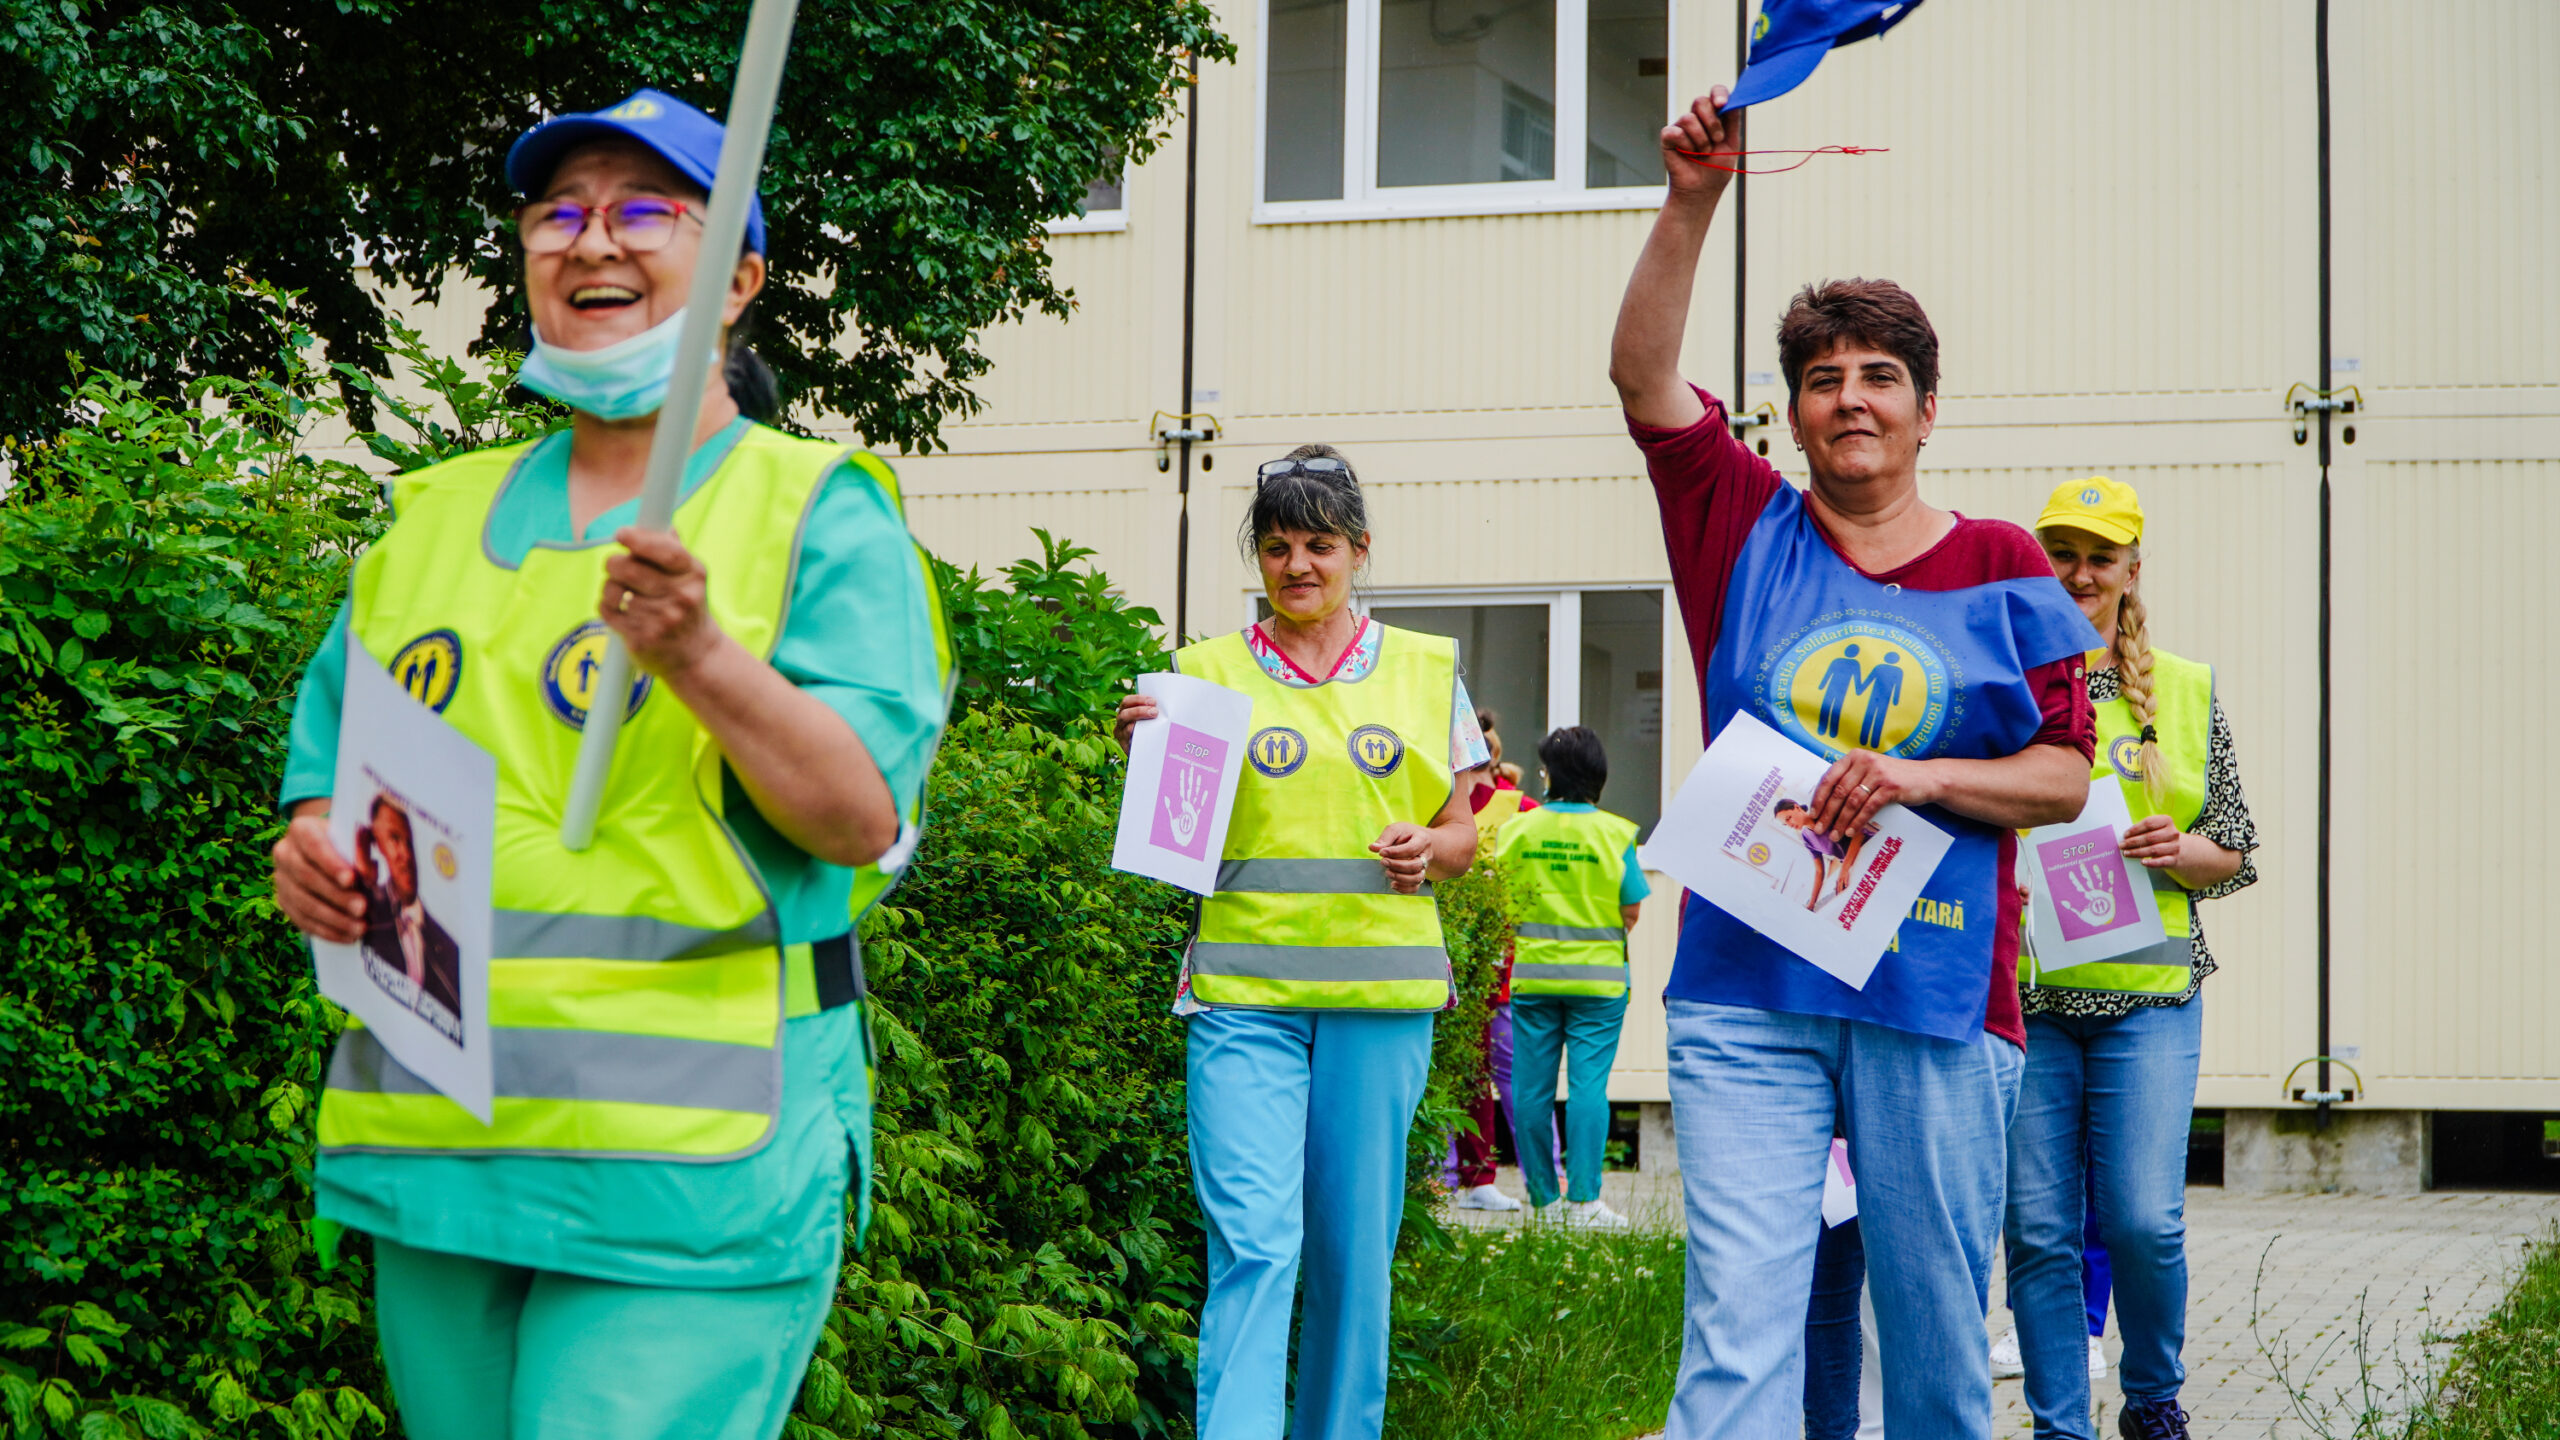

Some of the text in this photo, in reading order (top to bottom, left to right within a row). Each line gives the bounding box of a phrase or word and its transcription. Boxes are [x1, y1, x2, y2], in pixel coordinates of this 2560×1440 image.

[1930, 672, 1944, 695] din
[1900, 702, 1943, 757] România
[1184, 741, 1210, 759] STOP
[1723, 830, 1739, 849] TESA
[1734, 811, 1750, 832] ESTE
[1746, 800, 1757, 814] AZI
[1741, 805, 1764, 837] SOLICITE
[2062, 841, 2096, 859] STOP
[1838, 874, 1871, 922] RESPECTAREA
